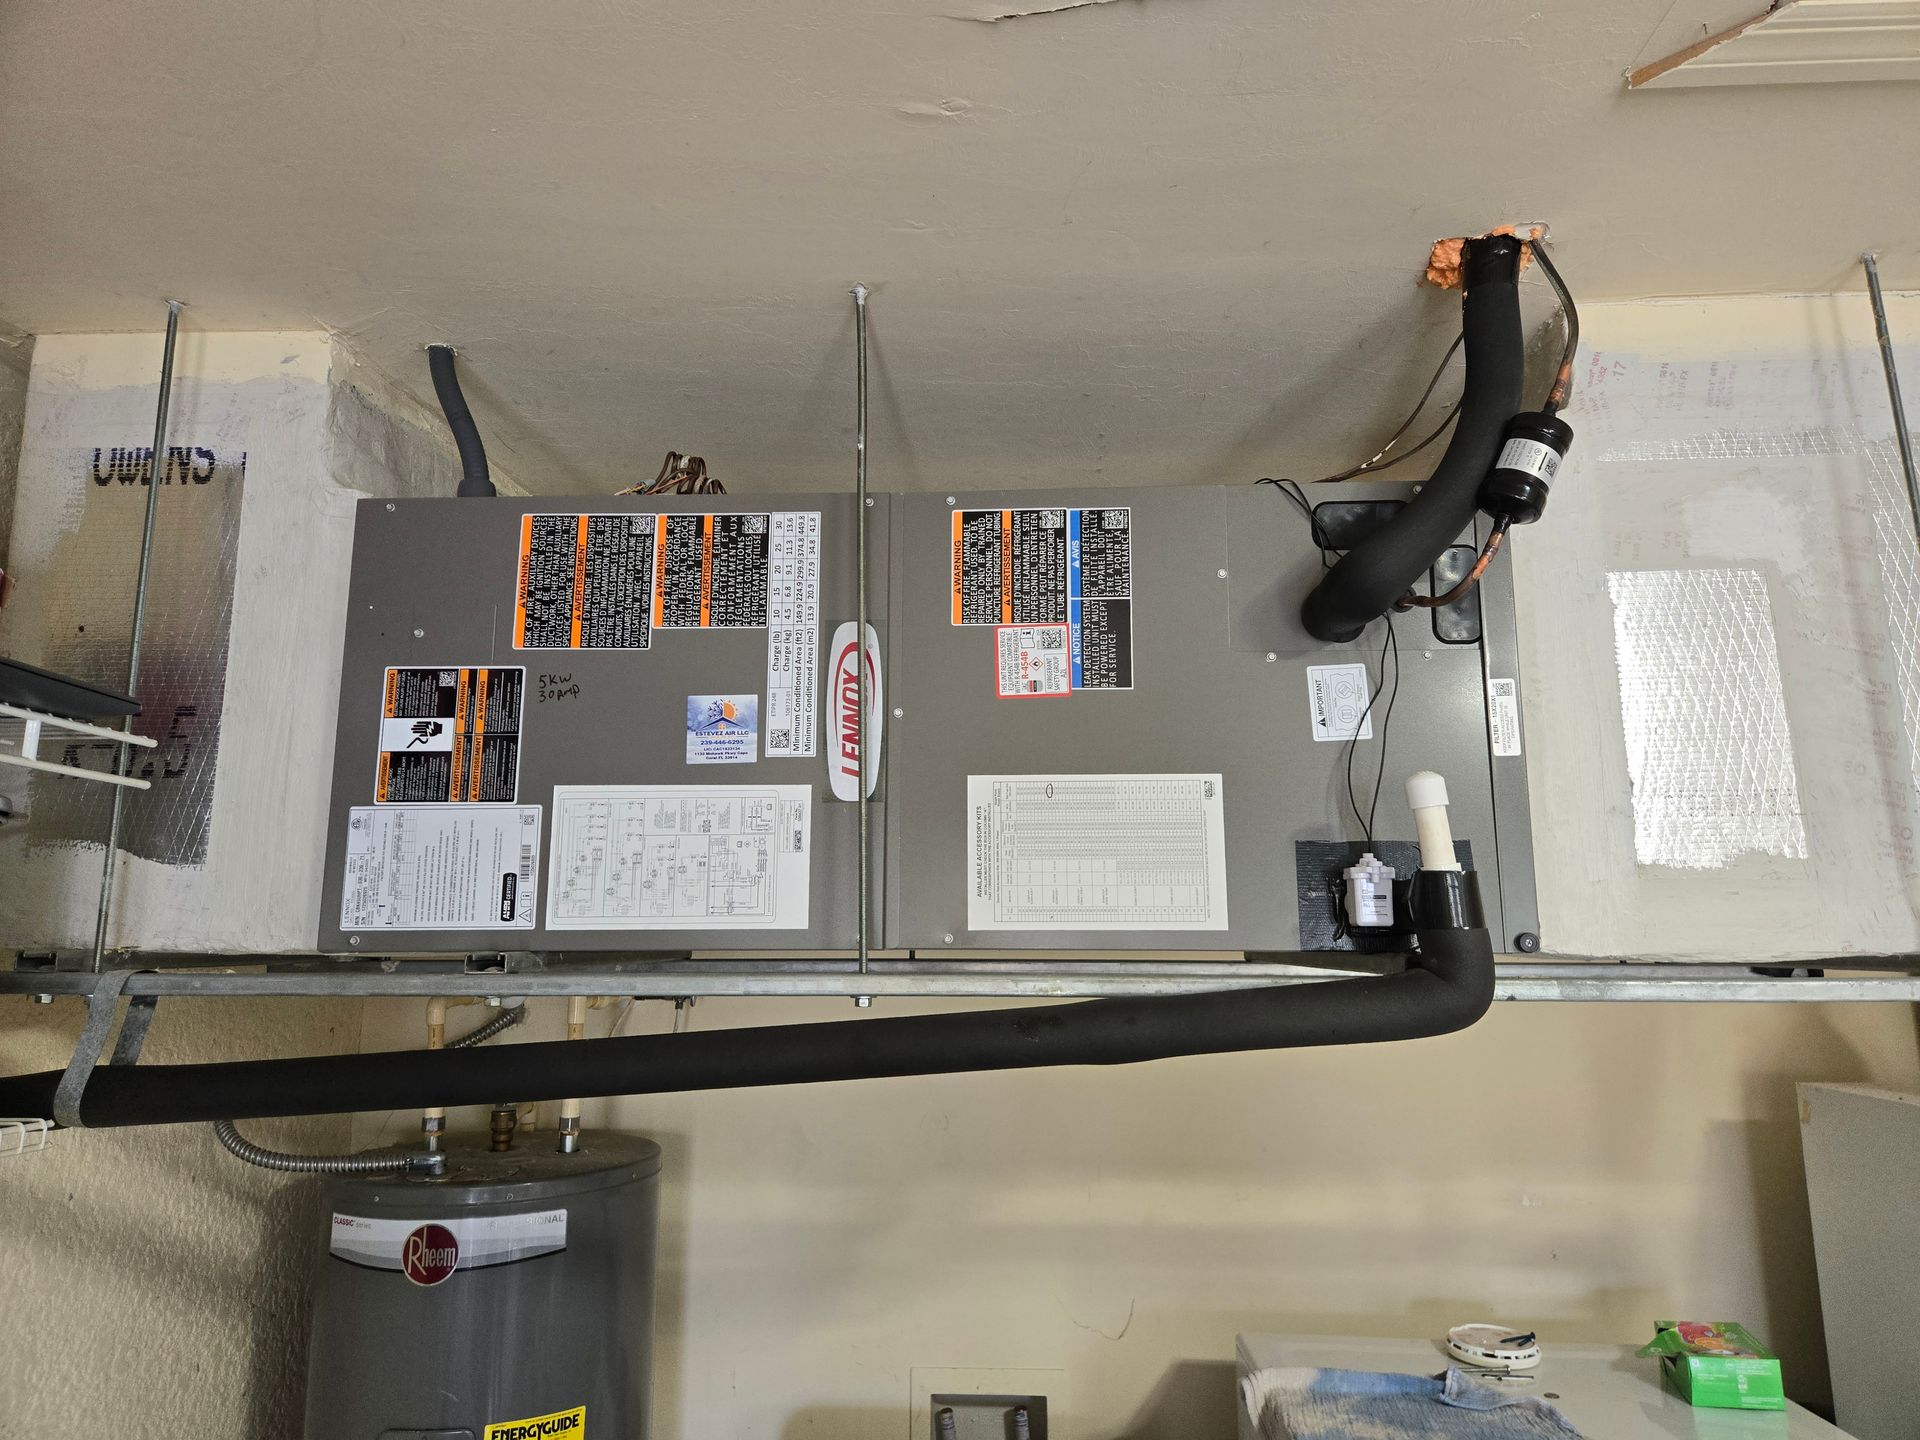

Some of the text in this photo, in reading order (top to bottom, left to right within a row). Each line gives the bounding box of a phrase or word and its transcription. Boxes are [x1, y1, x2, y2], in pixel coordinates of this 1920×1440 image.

[667, 518, 673, 528] OF
[776, 521, 782, 529] 30
[971, 521, 977, 530] BE
[539, 517, 547, 550] SOURCES
[971, 533, 977, 542] TO
[986, 531, 992, 542] DO
[568, 516, 577, 565] INSTRUCTIONS.
[673, 517, 681, 572] ACCORDANCE
[681, 547, 687, 558] OR
[775, 543, 782, 552] 25
[978, 554, 985, 563] BY
[528, 551, 537, 591] AUXILIARY
[536, 555, 545, 588] IGNITION
[703, 532, 711, 600] AVERTISSEMENT
[774, 565, 781, 574] 20
[520, 555, 529, 600] WARNING
[548, 602, 557, 646] DUCTWORK,
[554, 516, 562, 552] AUXILIARY
[575, 544, 585, 612] AVERTISSEMENT
[672, 575, 679, 583] IN
[536, 590, 542, 599] BE
[693, 567, 701, 627] REFRIGERANT
[774, 588, 781, 596] 15
[664, 595, 671, 605] OF
[964, 595, 970, 604] OF
[774, 610, 780, 618] 10
[526, 618, 533, 627] OF
[783, 630, 791, 643] (kg)
[1101, 678, 1108, 688] BE
[1316, 680, 1324, 716] IMPORTANT
[452, 737, 462, 792] AVERTISSEMENT
[472, 737, 481, 792] AVERTISSEMENT
[334, 1217, 354, 1227] CLASSIC
[408, 1226, 456, 1276] Rheem
[491, 1414, 580, 1440] ENERGYGUIDE
